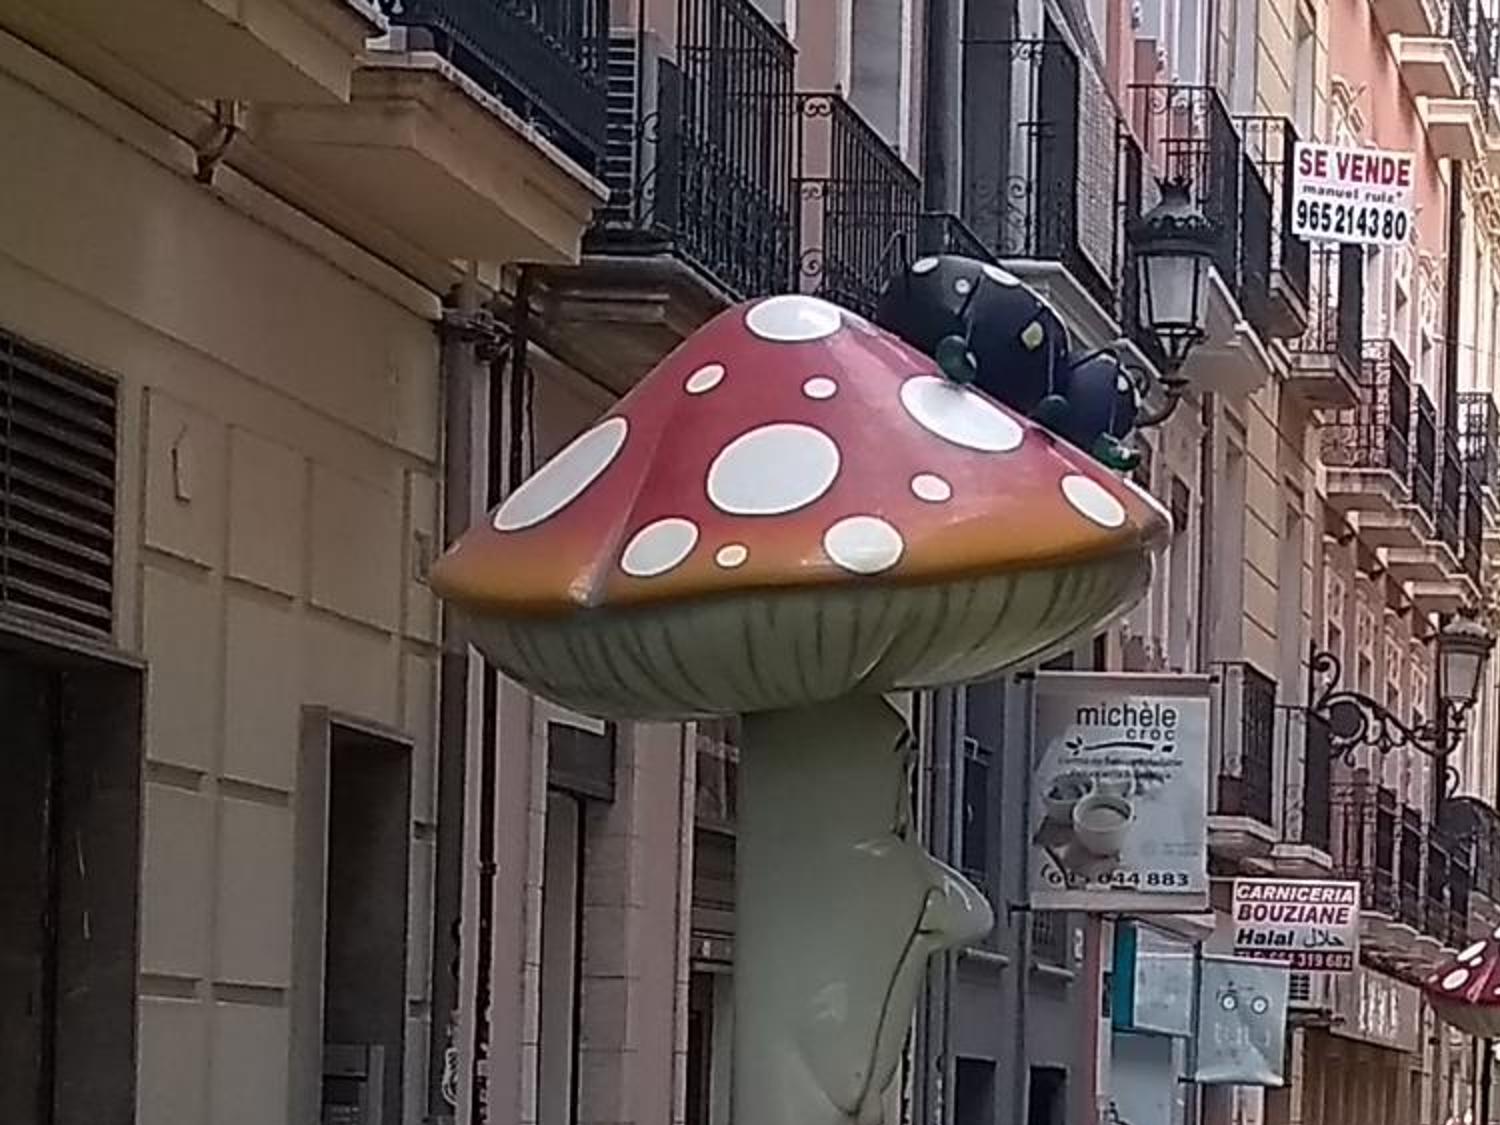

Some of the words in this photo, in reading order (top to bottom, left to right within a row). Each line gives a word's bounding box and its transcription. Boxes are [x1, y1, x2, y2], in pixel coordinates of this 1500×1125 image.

[1299, 148, 1328, 177] SE
[1336, 151, 1411, 186] VENDE
[1077, 702, 1177, 728] michèle
[1126, 728, 1175, 741] croc
[1146, 871, 1189, 887] 883
[1236, 884, 1353, 904] CARNICERIA
[1237, 904, 1349, 925] BOUZIANE
[1237, 929, 1294, 946] Halal
[1303, 928, 1344, 948] حلال
